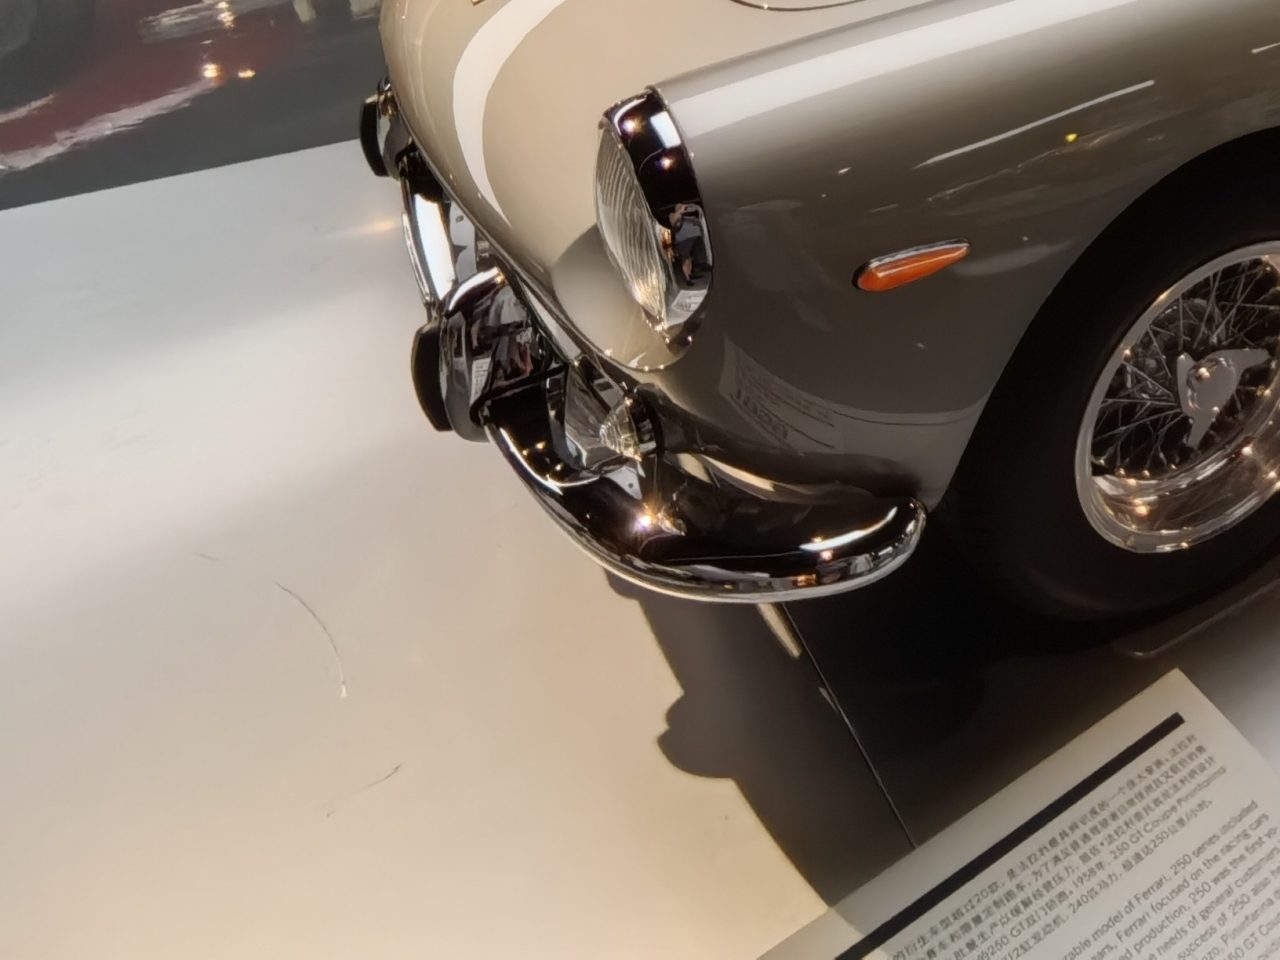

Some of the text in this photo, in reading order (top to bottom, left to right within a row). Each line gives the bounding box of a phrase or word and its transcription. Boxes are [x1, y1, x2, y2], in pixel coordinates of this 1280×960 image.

[1090, 908, 1123, 940] model
[1123, 900, 1134, 915] of
[1170, 853, 1191, 874] 250
[1116, 909, 1150, 942] Ferrari
[1150, 877, 1189, 913] focused
[1190, 867, 1203, 880] on
[1202, 851, 1219, 869] the
[1247, 811, 1268, 832] cars
[1156, 924, 1187, 954] needs
[1186, 914, 1198, 929] of
[1198, 885, 1235, 919] general
[1234, 845, 1280, 888] customers
[1188, 880, 1211, 904] 250
[1210, 866, 1230, 885] was
[1228, 851, 1245, 870] the
[1245, 836, 1264, 855] first
[1176, 924, 1217, 960] success
[1215, 912, 1227, 926] of
[1228, 892, 1250, 915] 250
[1242, 931, 1259, 950] GT
